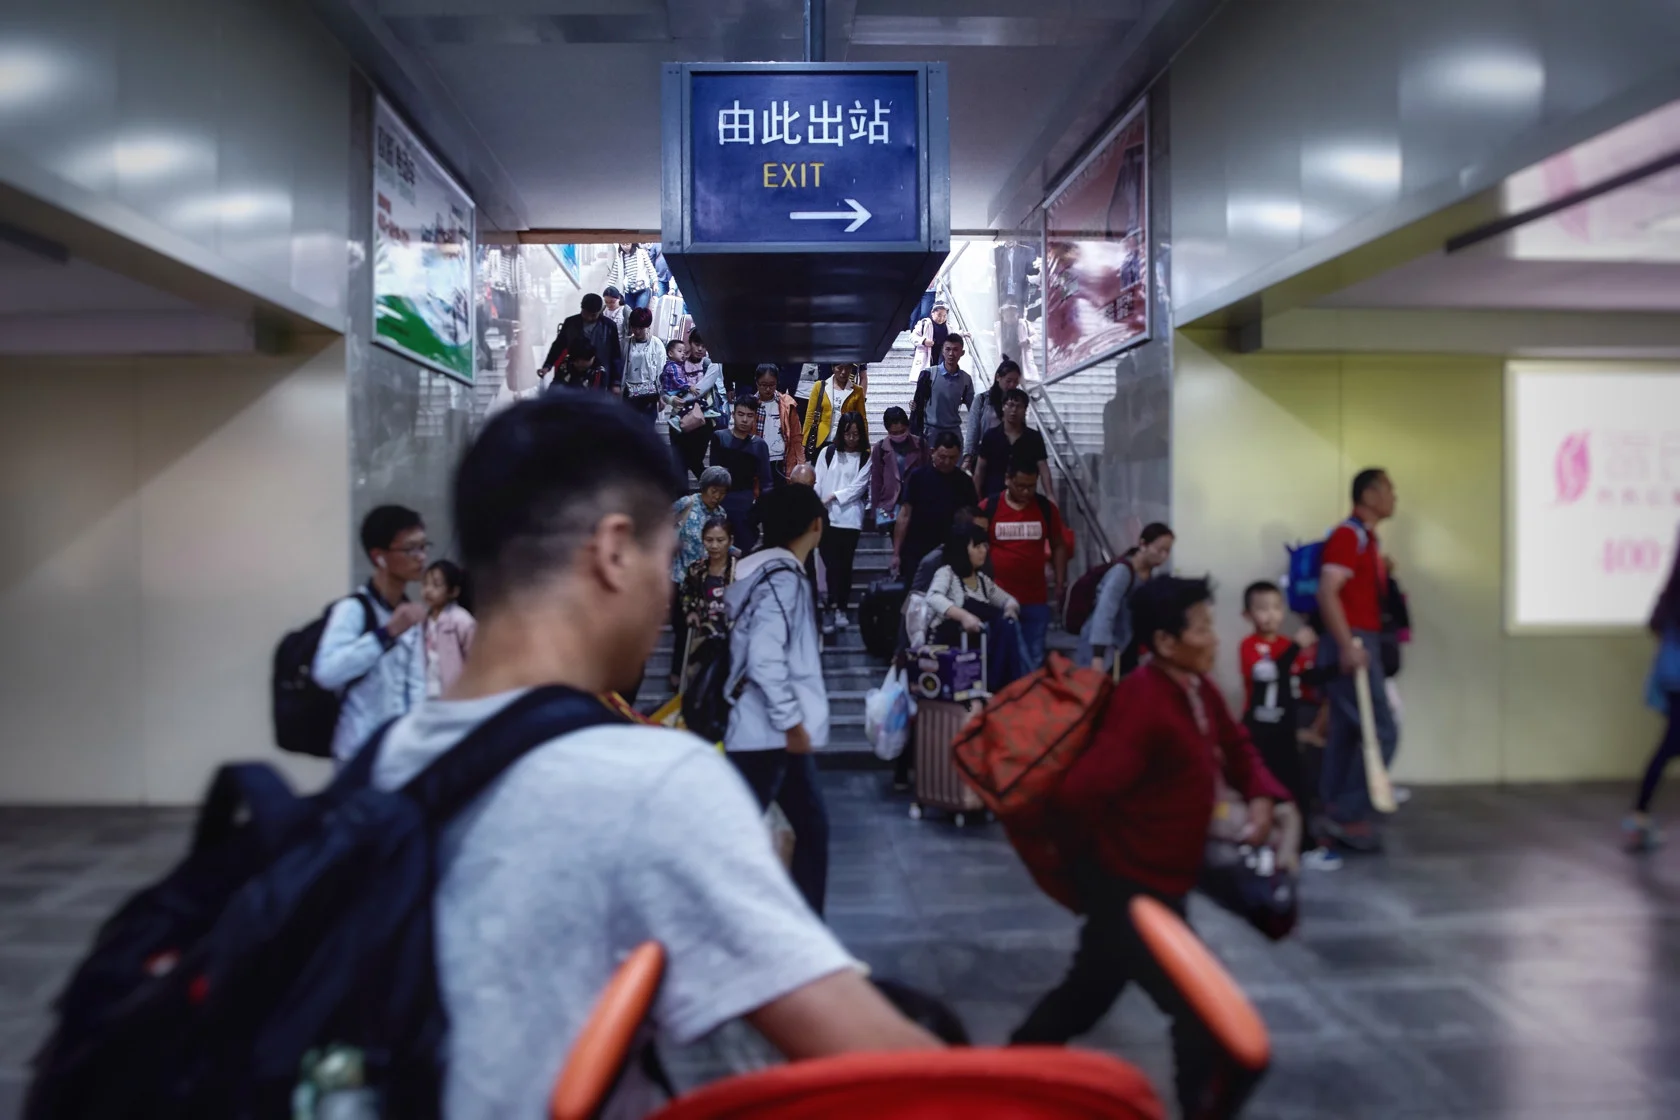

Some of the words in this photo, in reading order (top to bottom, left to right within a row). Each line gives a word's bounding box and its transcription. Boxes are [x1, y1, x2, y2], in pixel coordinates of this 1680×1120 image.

[718, 100, 891, 146] 由此出站
[763, 162, 824, 187] EXIT
